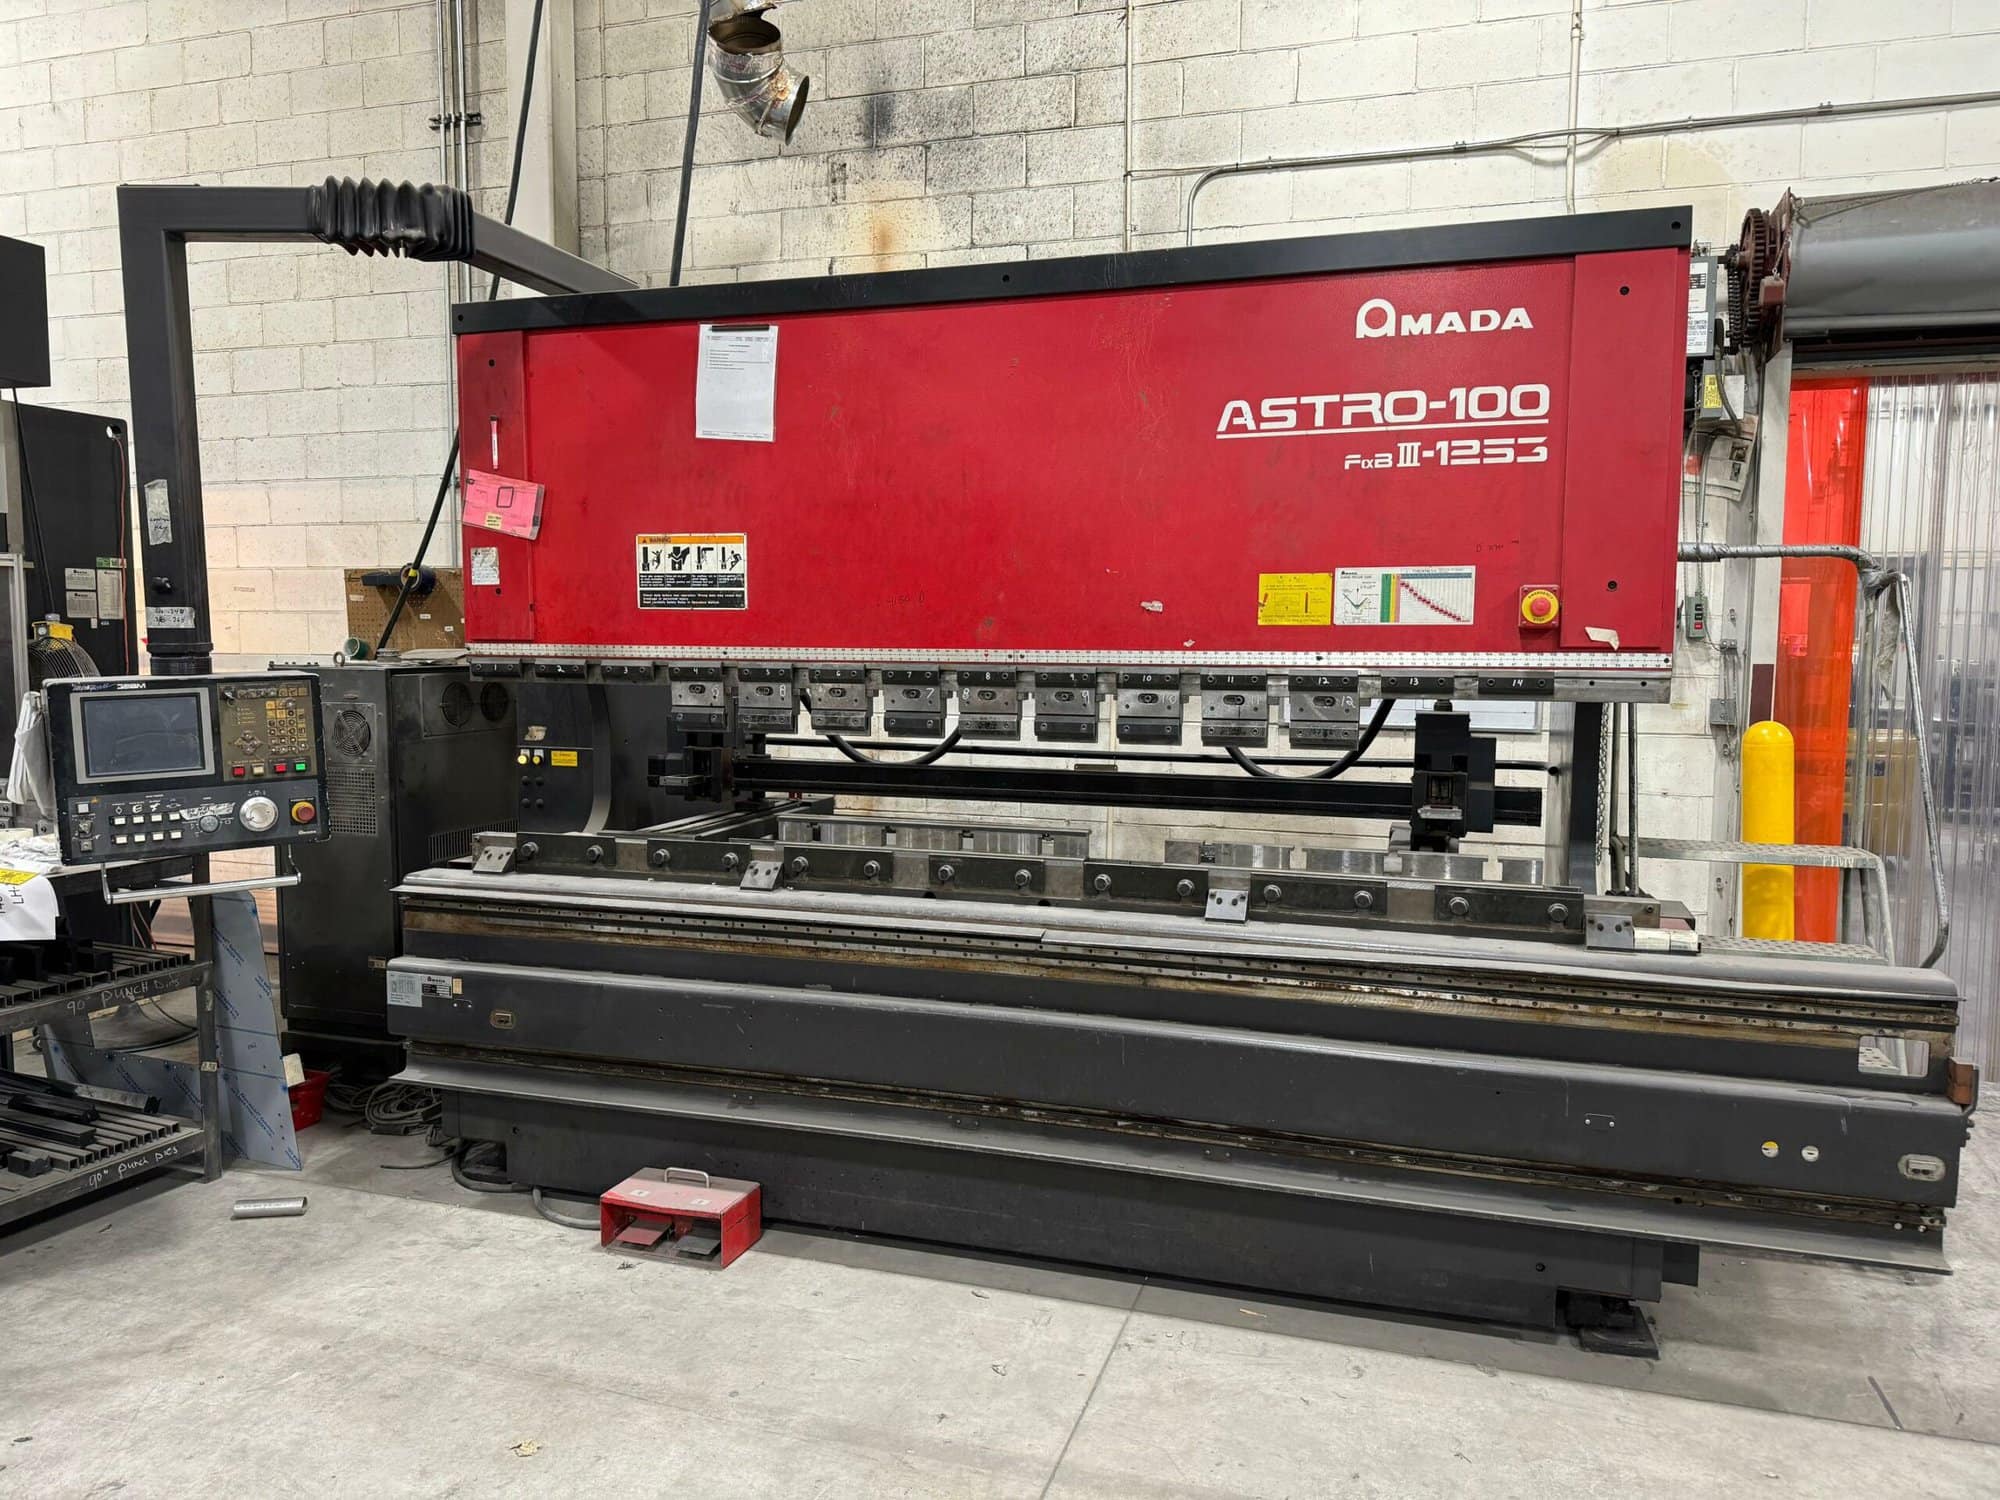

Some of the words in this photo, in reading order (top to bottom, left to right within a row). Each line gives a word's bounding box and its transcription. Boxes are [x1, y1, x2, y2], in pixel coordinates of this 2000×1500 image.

[1355, 298, 1534, 338] AMADA
[1216, 383, 1550, 432] ASTRO-100
[556, 665, 565, 673] 2
[1142, 674, 1152, 682] 10
[1227, 675, 1234, 684] 11
[1318, 676, 1330, 685] 12
[1409, 677, 1419, 686] 13
[1512, 678, 1523, 687] 14
[926, 687, 935, 699] 7
[962, 687, 970, 700] 8
[1340, 694, 1356, 709] 12
